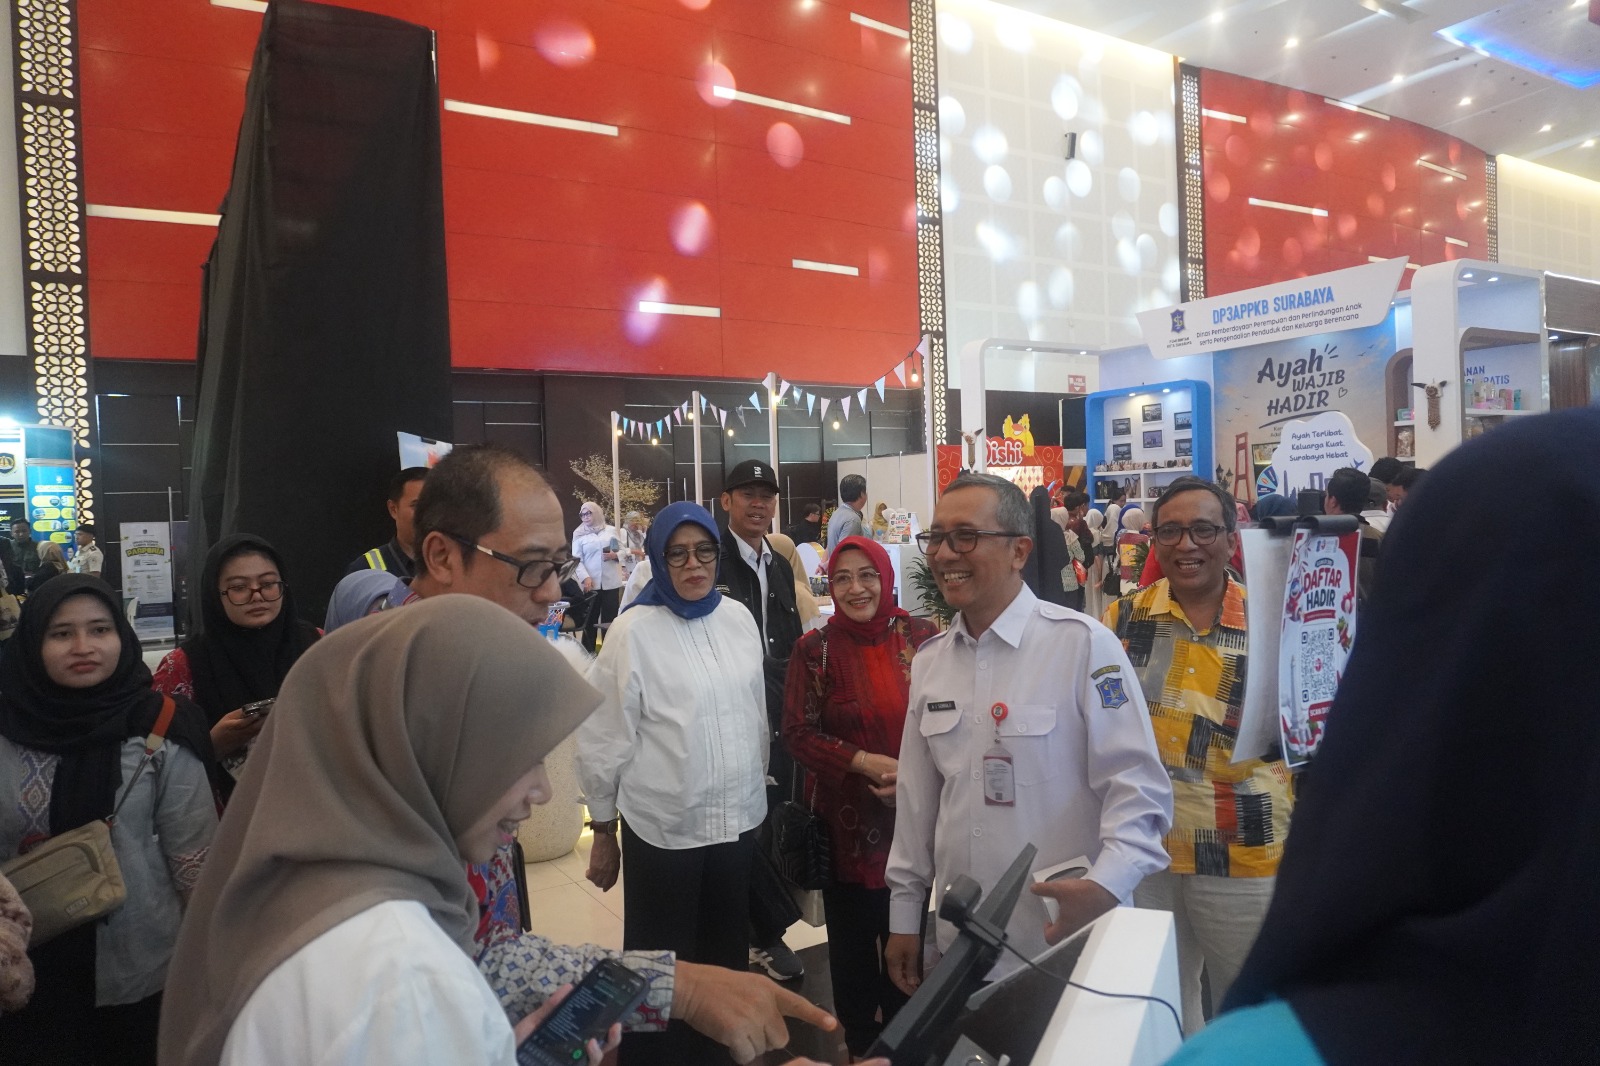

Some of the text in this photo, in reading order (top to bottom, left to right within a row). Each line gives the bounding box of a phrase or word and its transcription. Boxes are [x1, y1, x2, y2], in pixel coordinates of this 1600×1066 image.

[1213, 286, 1335, 325] DP3APPKB SURABAYA
[1196, 302, 1363, 339] Dinas Pemberdayaan Perempuan dan Perlindungan Anak
[1200, 313, 1360, 347] serta Pengendalian Penduduk dan Keluarga Berencana
[1257, 348, 1323, 388] Ayah
[1481, 374, 1510, 385] RATIS
[1292, 369, 1345, 392] WAJIB
[1267, 390, 1330, 416] HADIR
[1291, 432, 1310, 441] Ayah
[1291, 441, 1324, 451] Keluarga
[1289, 450, 1349, 462] Surabaya Hebat
[1304, 567, 1342, 594] DAFTAR
[1306, 588, 1336, 611] HADIR
